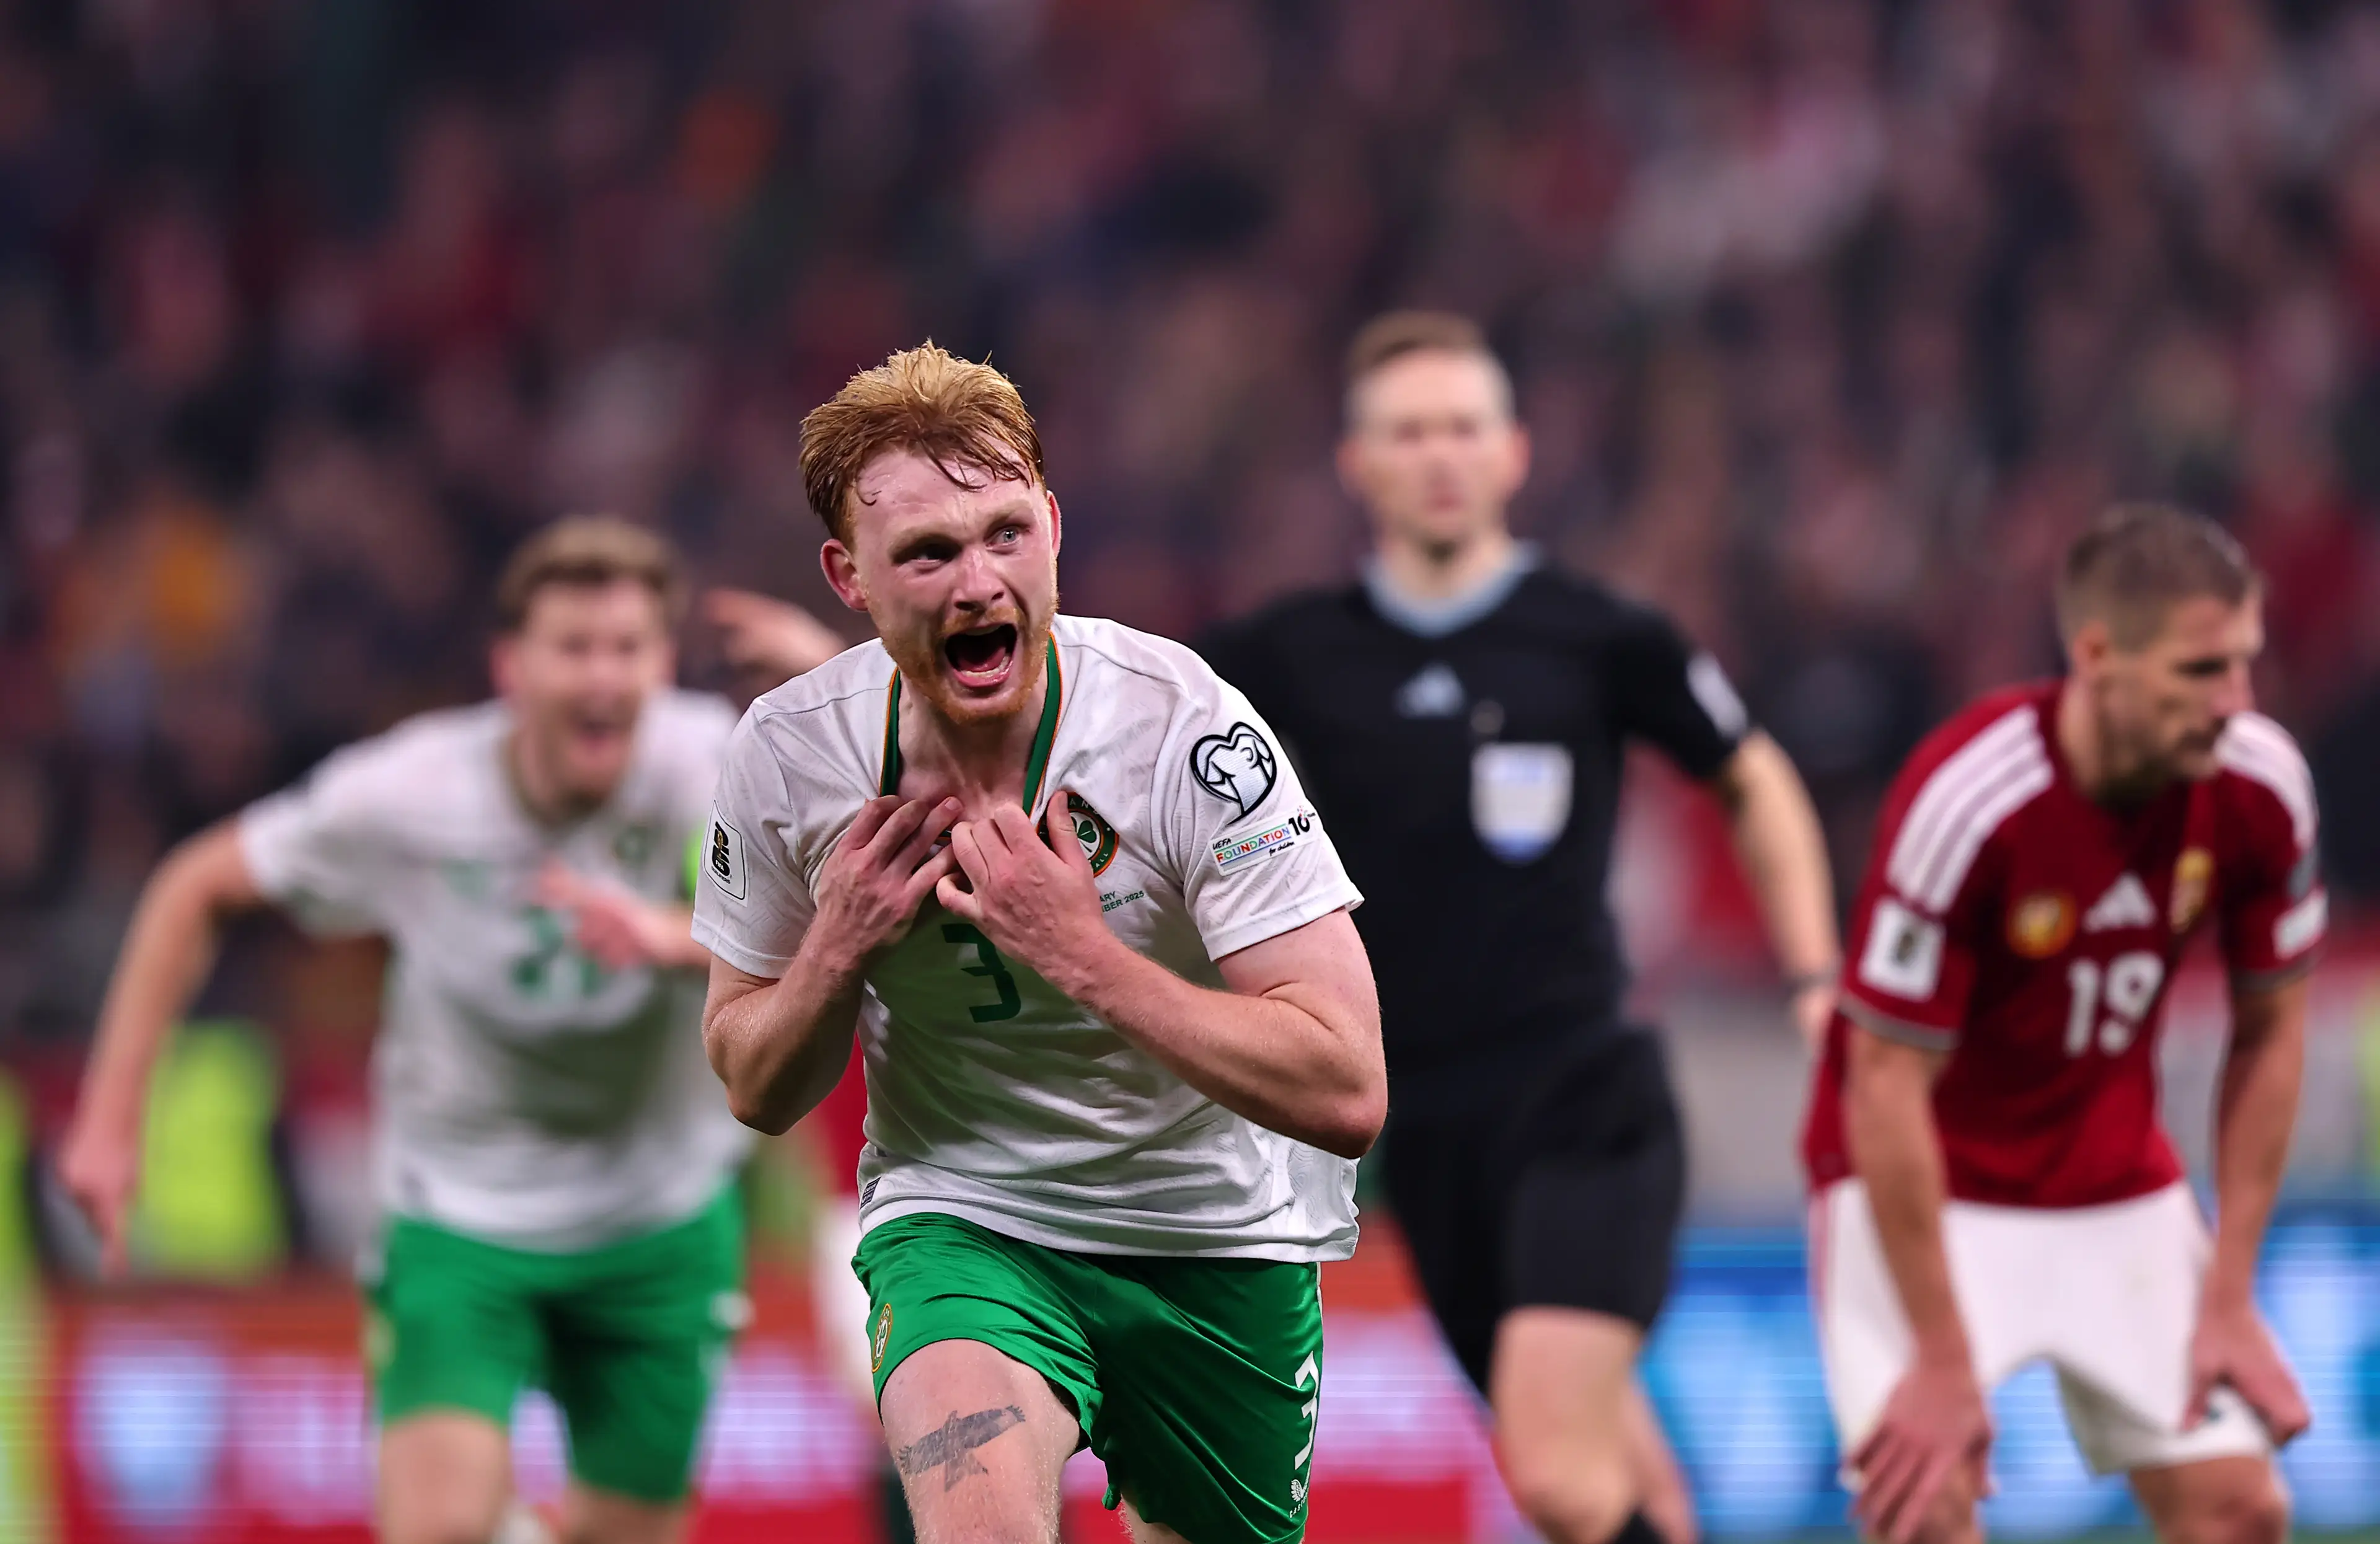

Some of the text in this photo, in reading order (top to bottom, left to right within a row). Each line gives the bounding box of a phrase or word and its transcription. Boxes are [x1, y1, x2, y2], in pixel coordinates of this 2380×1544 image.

[1288, 814, 1310, 836] 10
[1212, 838, 1232, 850] UEFA
[1216, 827, 1290, 863] FOUNDATION
[715, 859, 725, 871] FIFA
[1100, 891, 1115, 902] ARY
[1102, 890, 1144, 912] BER 2025
[940, 923, 1021, 1023] 3
[2063, 951, 2164, 1059] 19
[1294, 1350, 1320, 1470] 3
